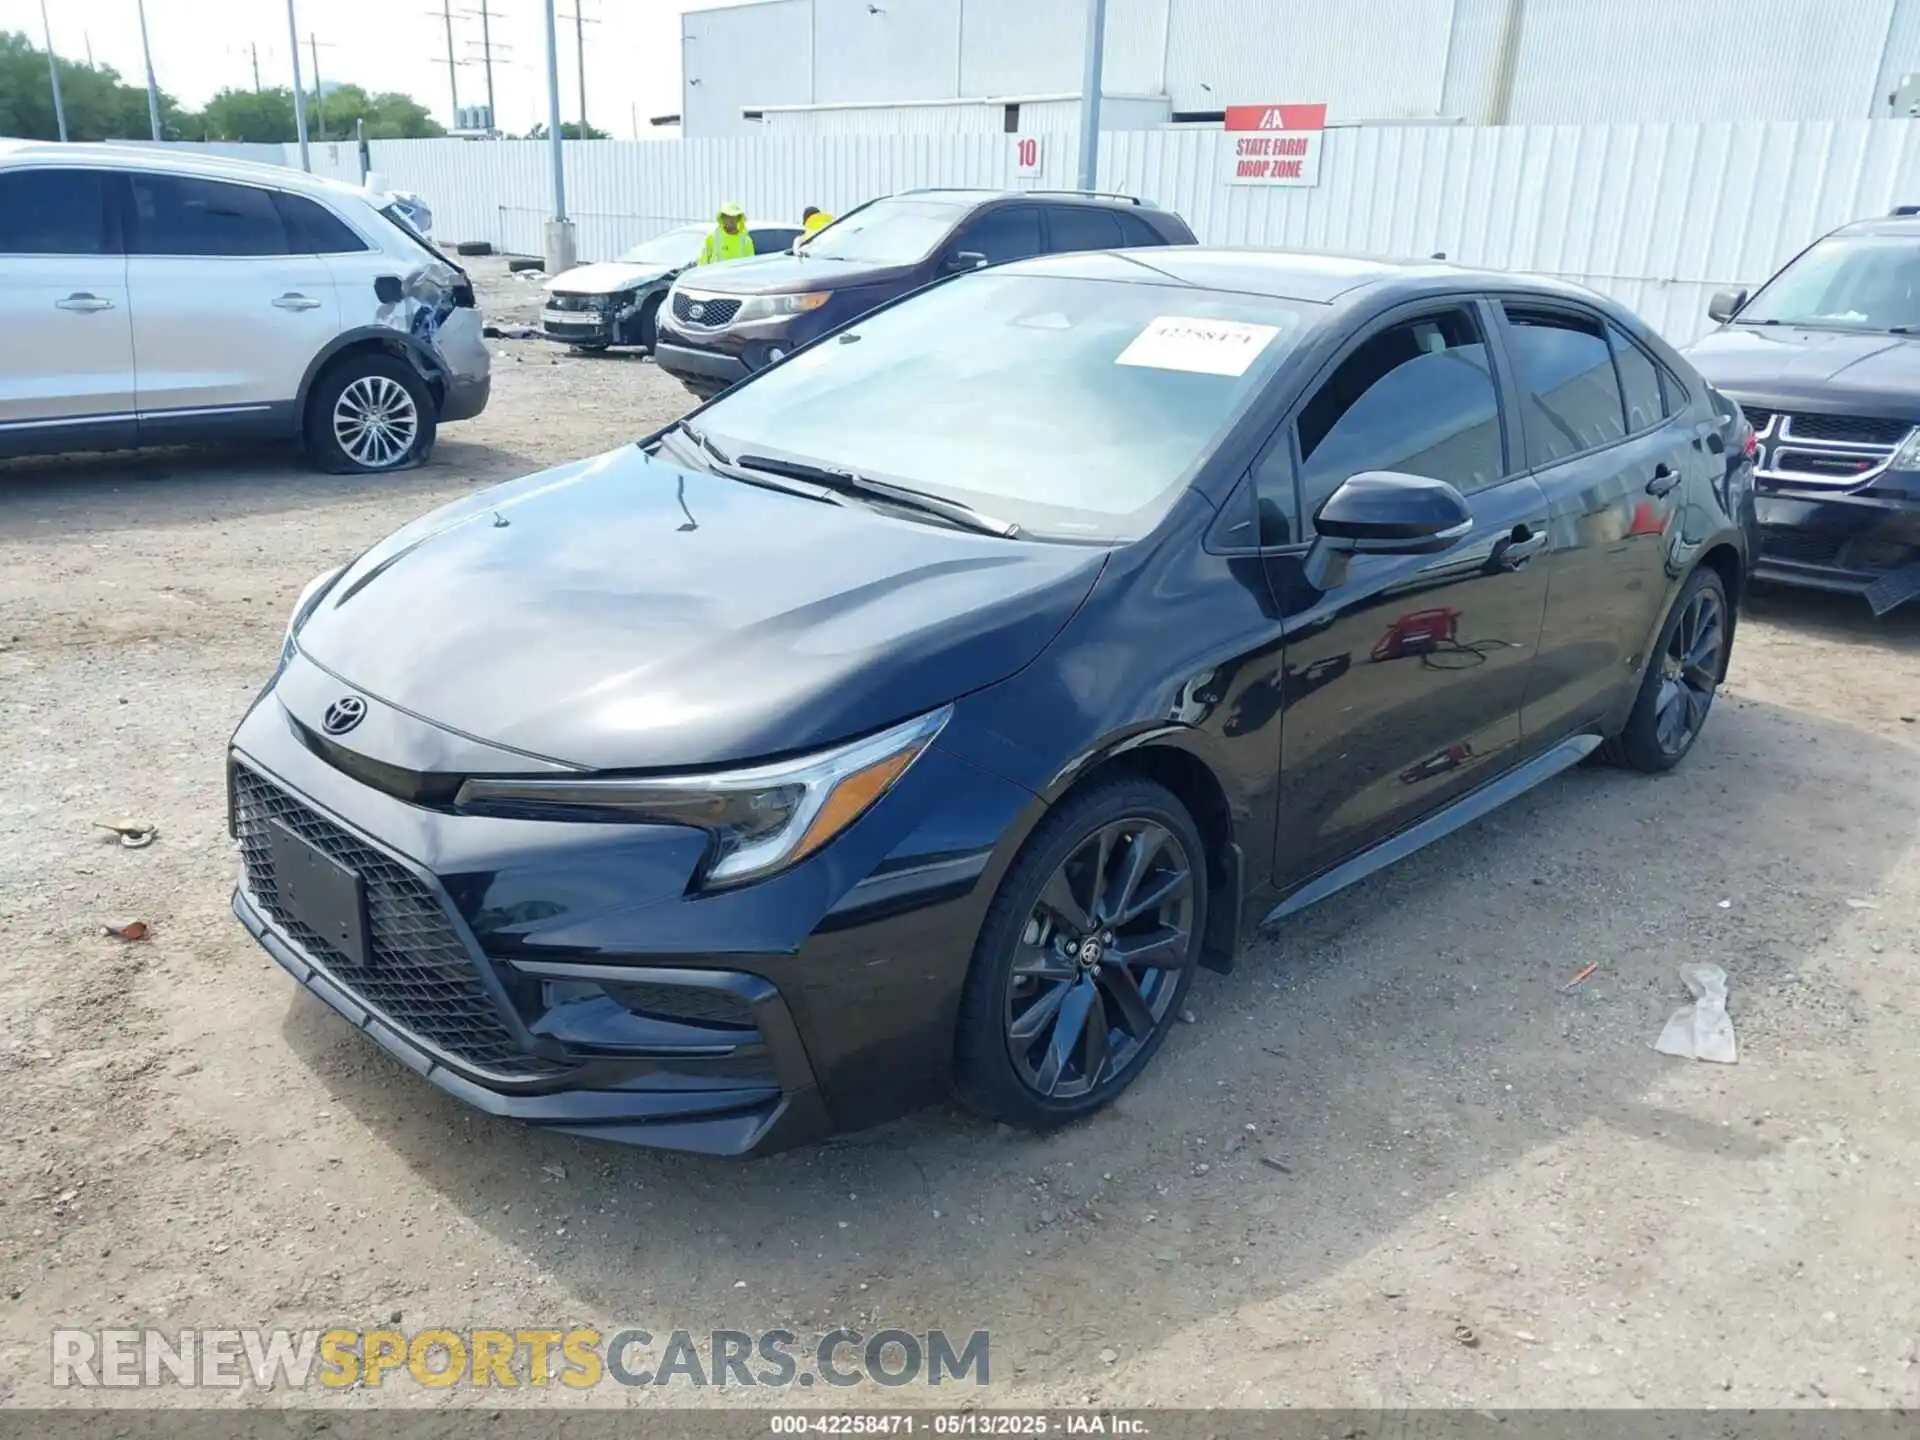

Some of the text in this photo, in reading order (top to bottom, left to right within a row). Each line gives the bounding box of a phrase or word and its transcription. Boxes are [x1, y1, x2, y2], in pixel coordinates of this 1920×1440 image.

[1017, 139, 1037, 167] 10
[1236, 138, 1309, 156] STATE FARM
[1236, 160, 1304, 178] DROP ZONE
